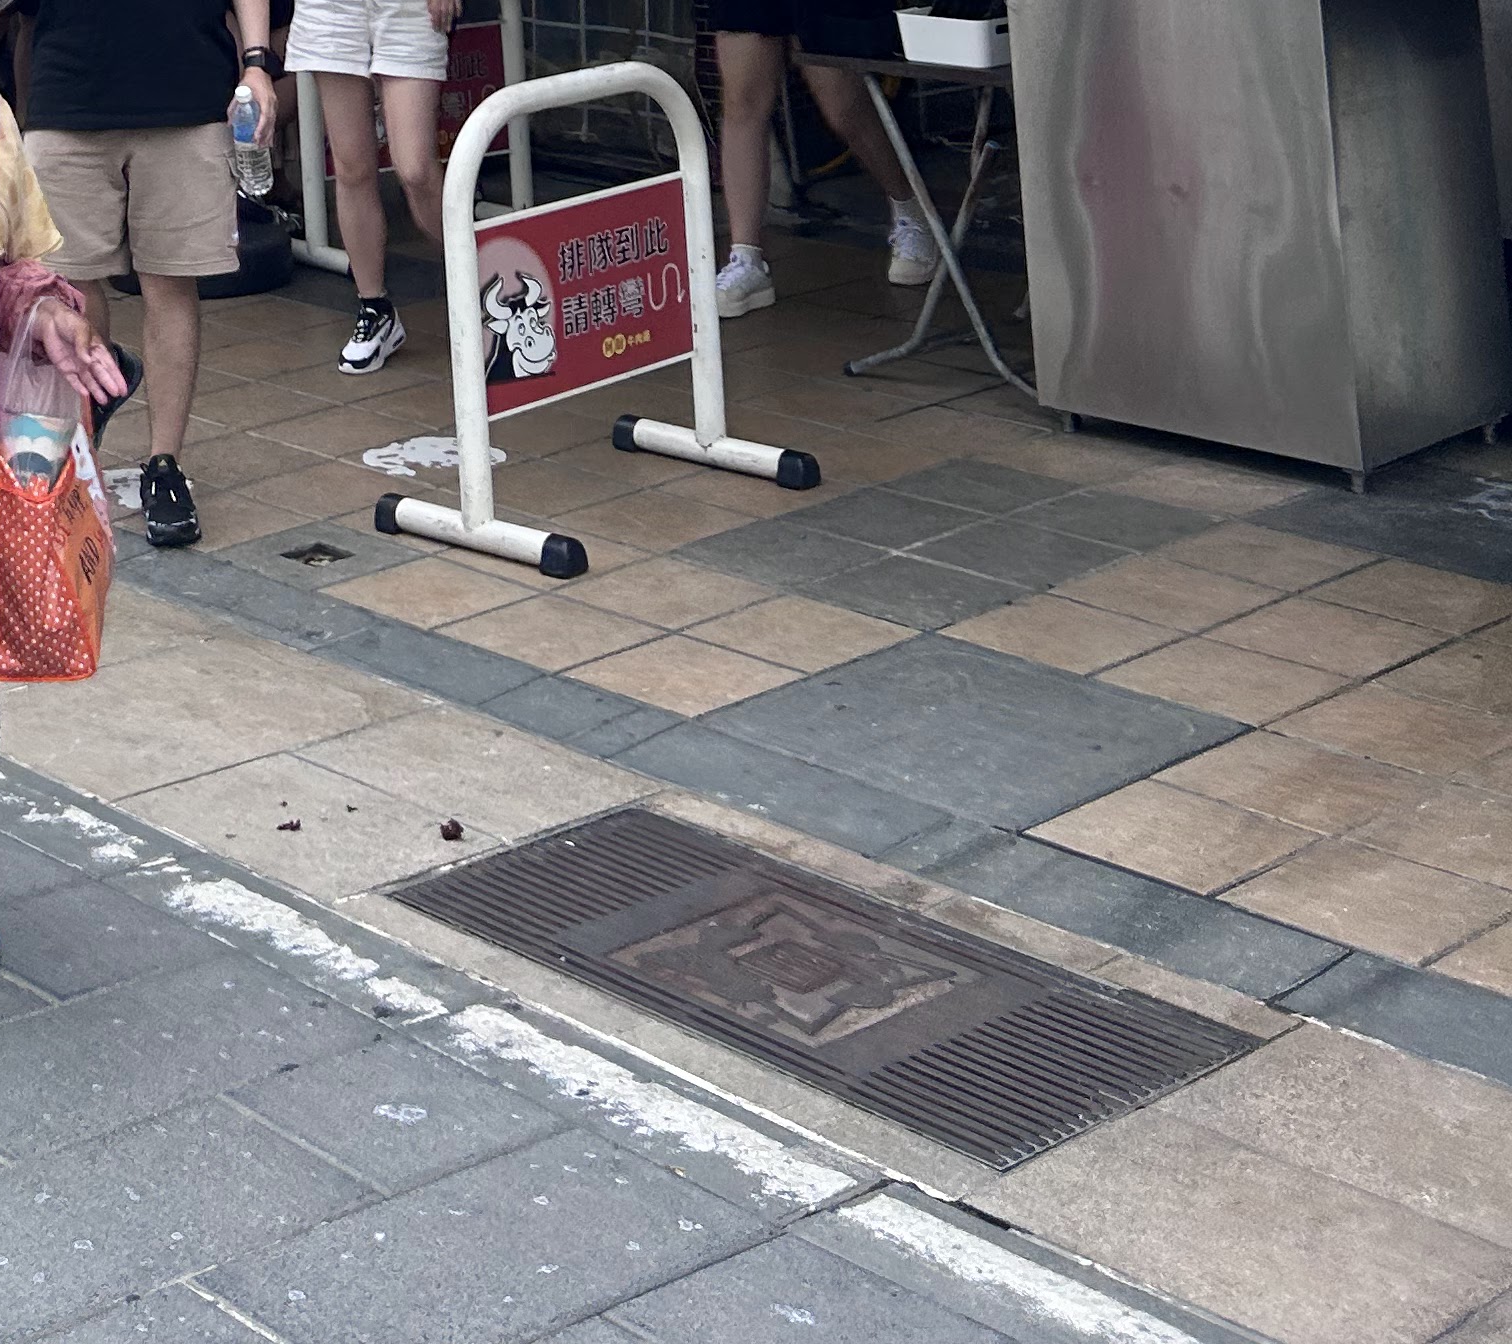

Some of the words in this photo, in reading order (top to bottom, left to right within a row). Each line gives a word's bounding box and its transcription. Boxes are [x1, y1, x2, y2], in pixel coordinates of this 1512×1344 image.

[558, 216, 669, 284] 排隊到此
[561, 275, 646, 340] 請轉彎
